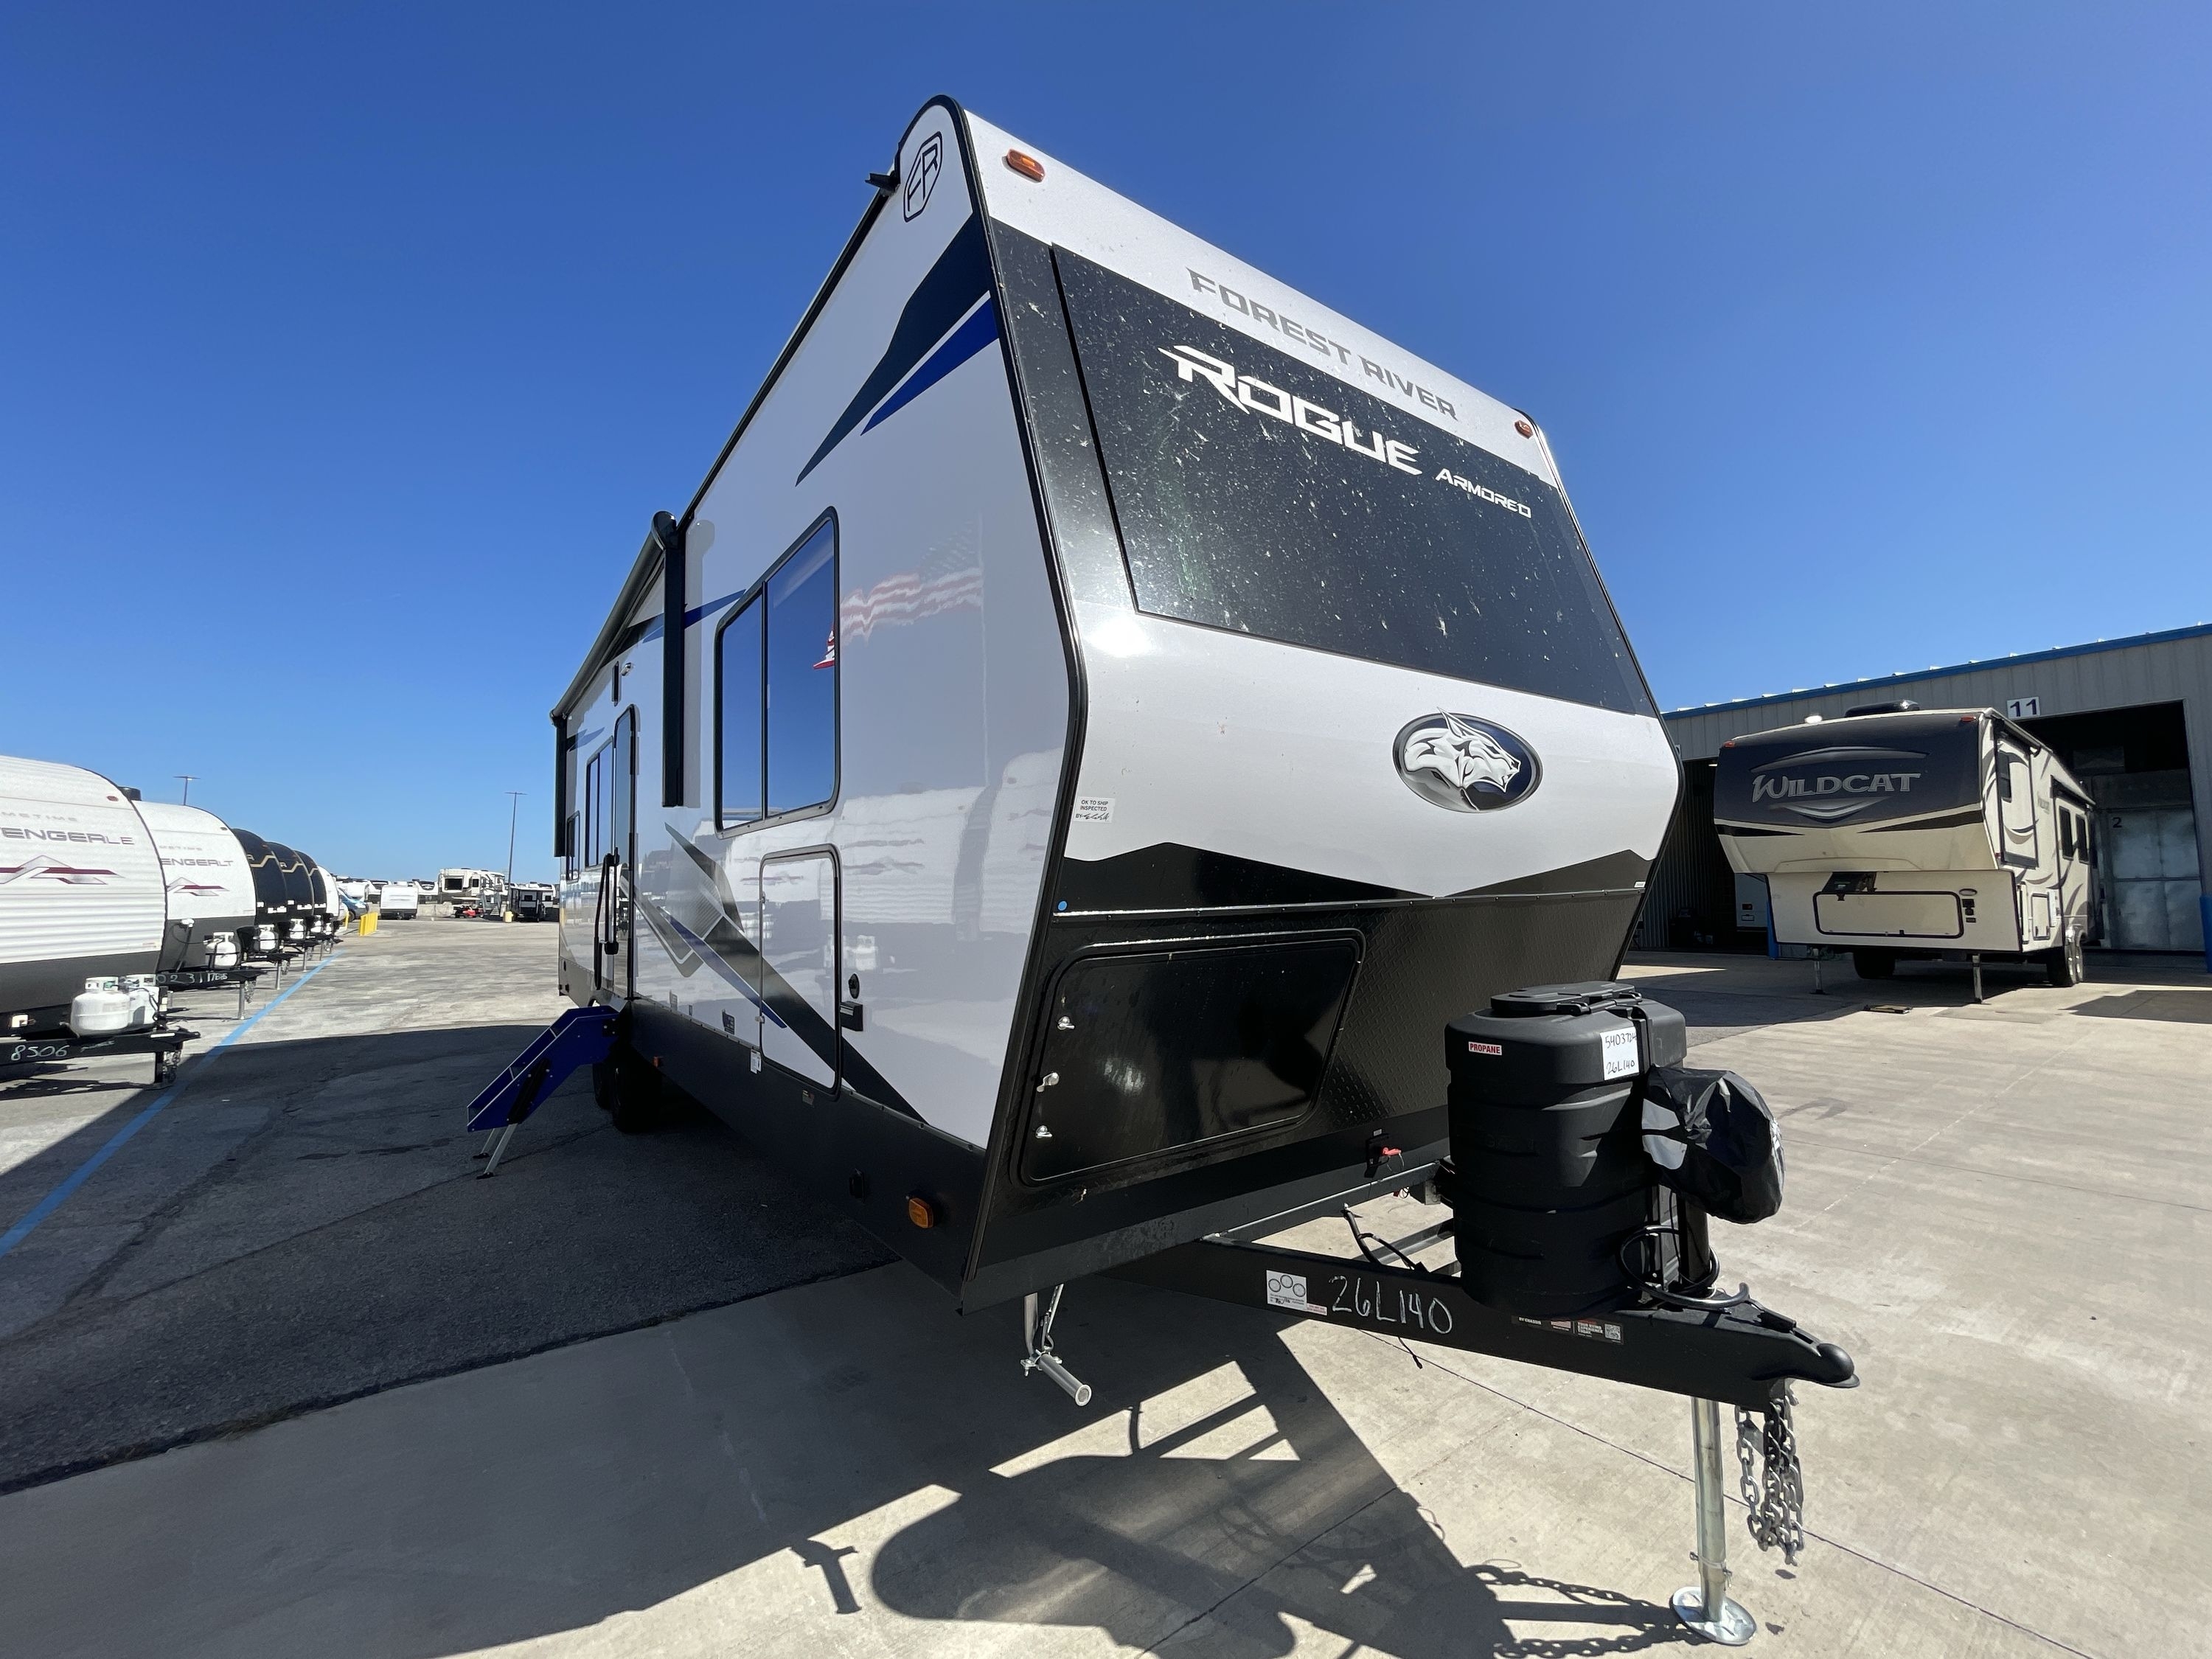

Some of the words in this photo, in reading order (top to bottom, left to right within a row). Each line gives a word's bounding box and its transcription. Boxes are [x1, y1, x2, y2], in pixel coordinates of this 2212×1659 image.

[1185, 266, 1351, 365] FOREST
[1358, 354, 1458, 420] RIVER
[1158, 345, 1423, 476] ROGUE
[1436, 468, 1532, 518] ARMORED
[2010, 699, 2038, 717] 11
[1752, 773, 1921, 803] WILDCAT
[2112, 817, 2122, 828] 2
[11, 1044, 70, 1061] 8506
[1470, 1043, 1501, 1054] PROPANE
[1328, 1275, 1453, 1335] 26L140
